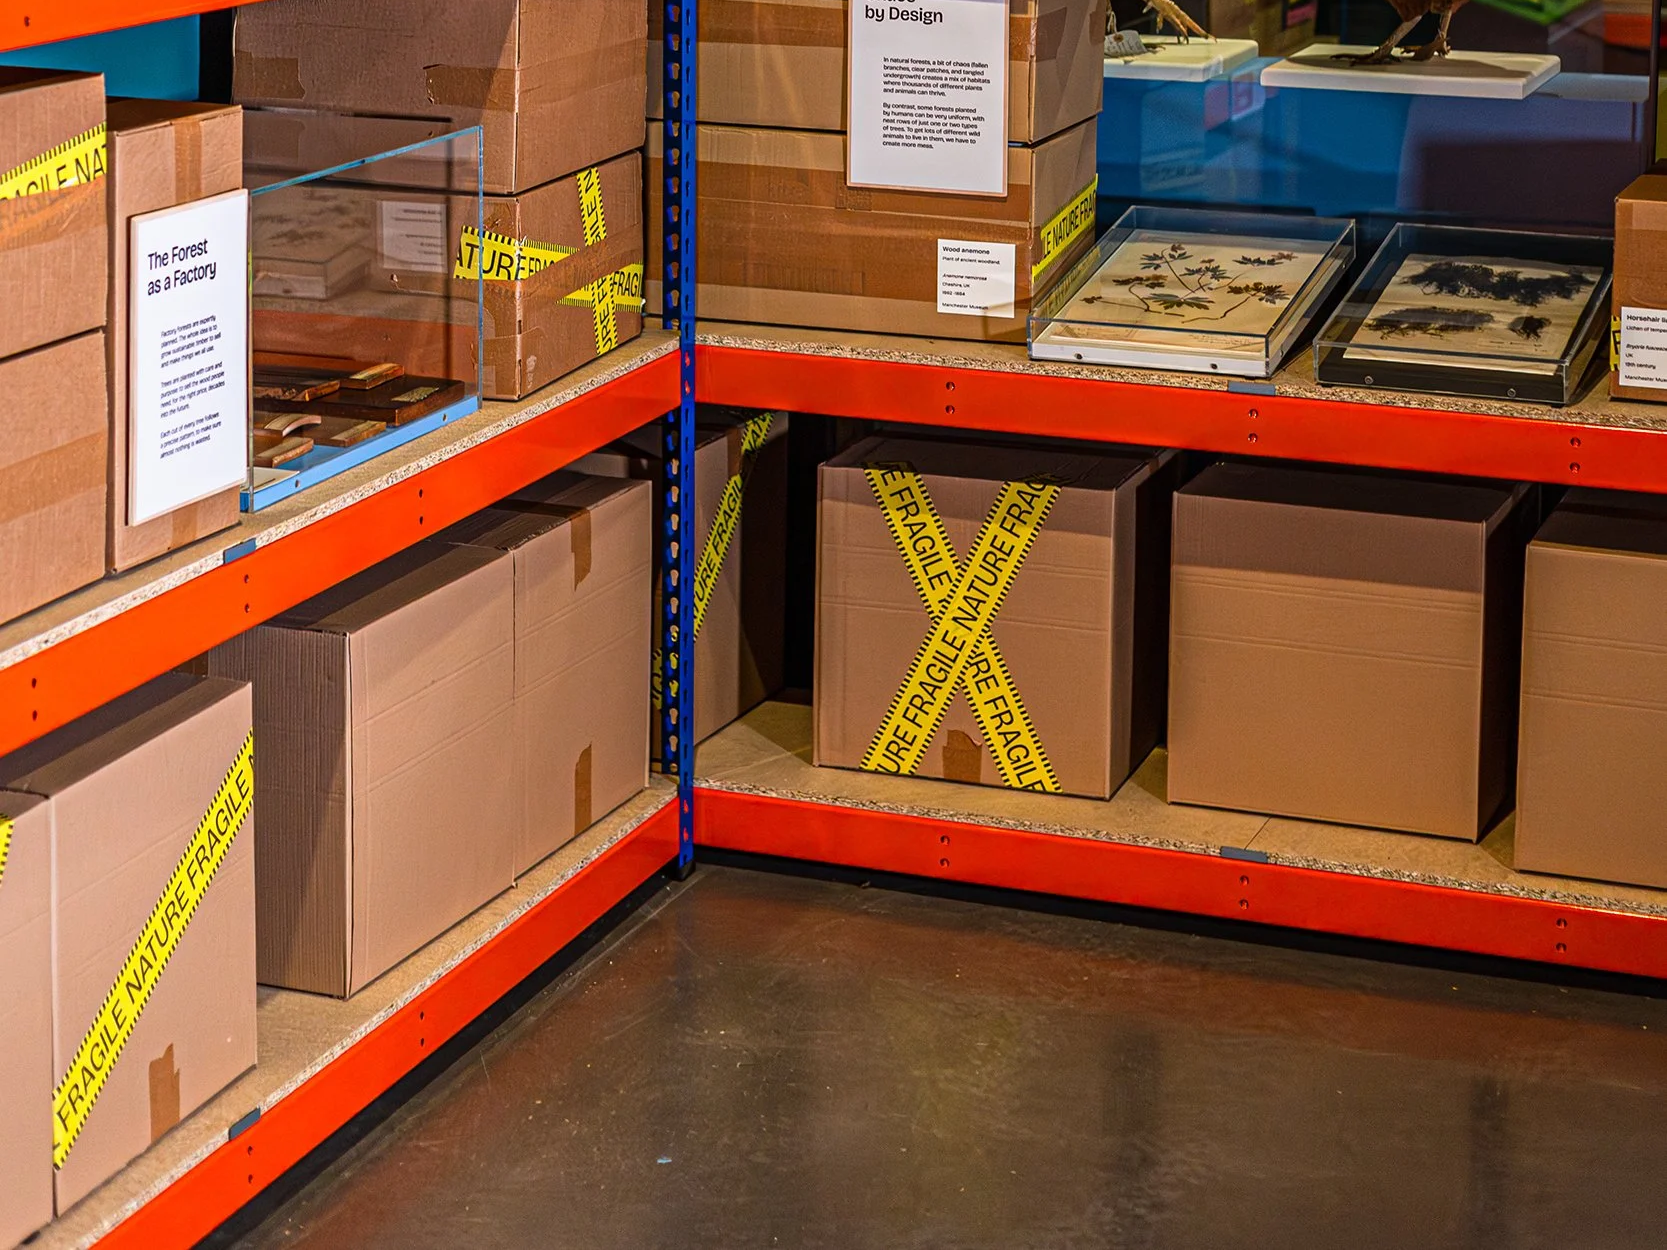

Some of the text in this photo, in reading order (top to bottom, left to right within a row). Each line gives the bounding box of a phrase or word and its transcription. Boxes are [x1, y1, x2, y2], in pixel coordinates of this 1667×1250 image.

[865, 5, 943, 25] by Design
[1053, 205, 1079, 250] NATURE
[148, 238, 208, 271] The Forest
[148, 260, 217, 296] as a Factory
[1626, 314, 1660, 323] Horsehair
[889, 487, 952, 590] FRAGILE
[875, 725, 917, 774] URE
[903, 630, 966, 729] FRAGILE
[951, 535, 1015, 631] NATURE
[58, 771, 250, 1131] FRAGILE NATURE FRAGILE
